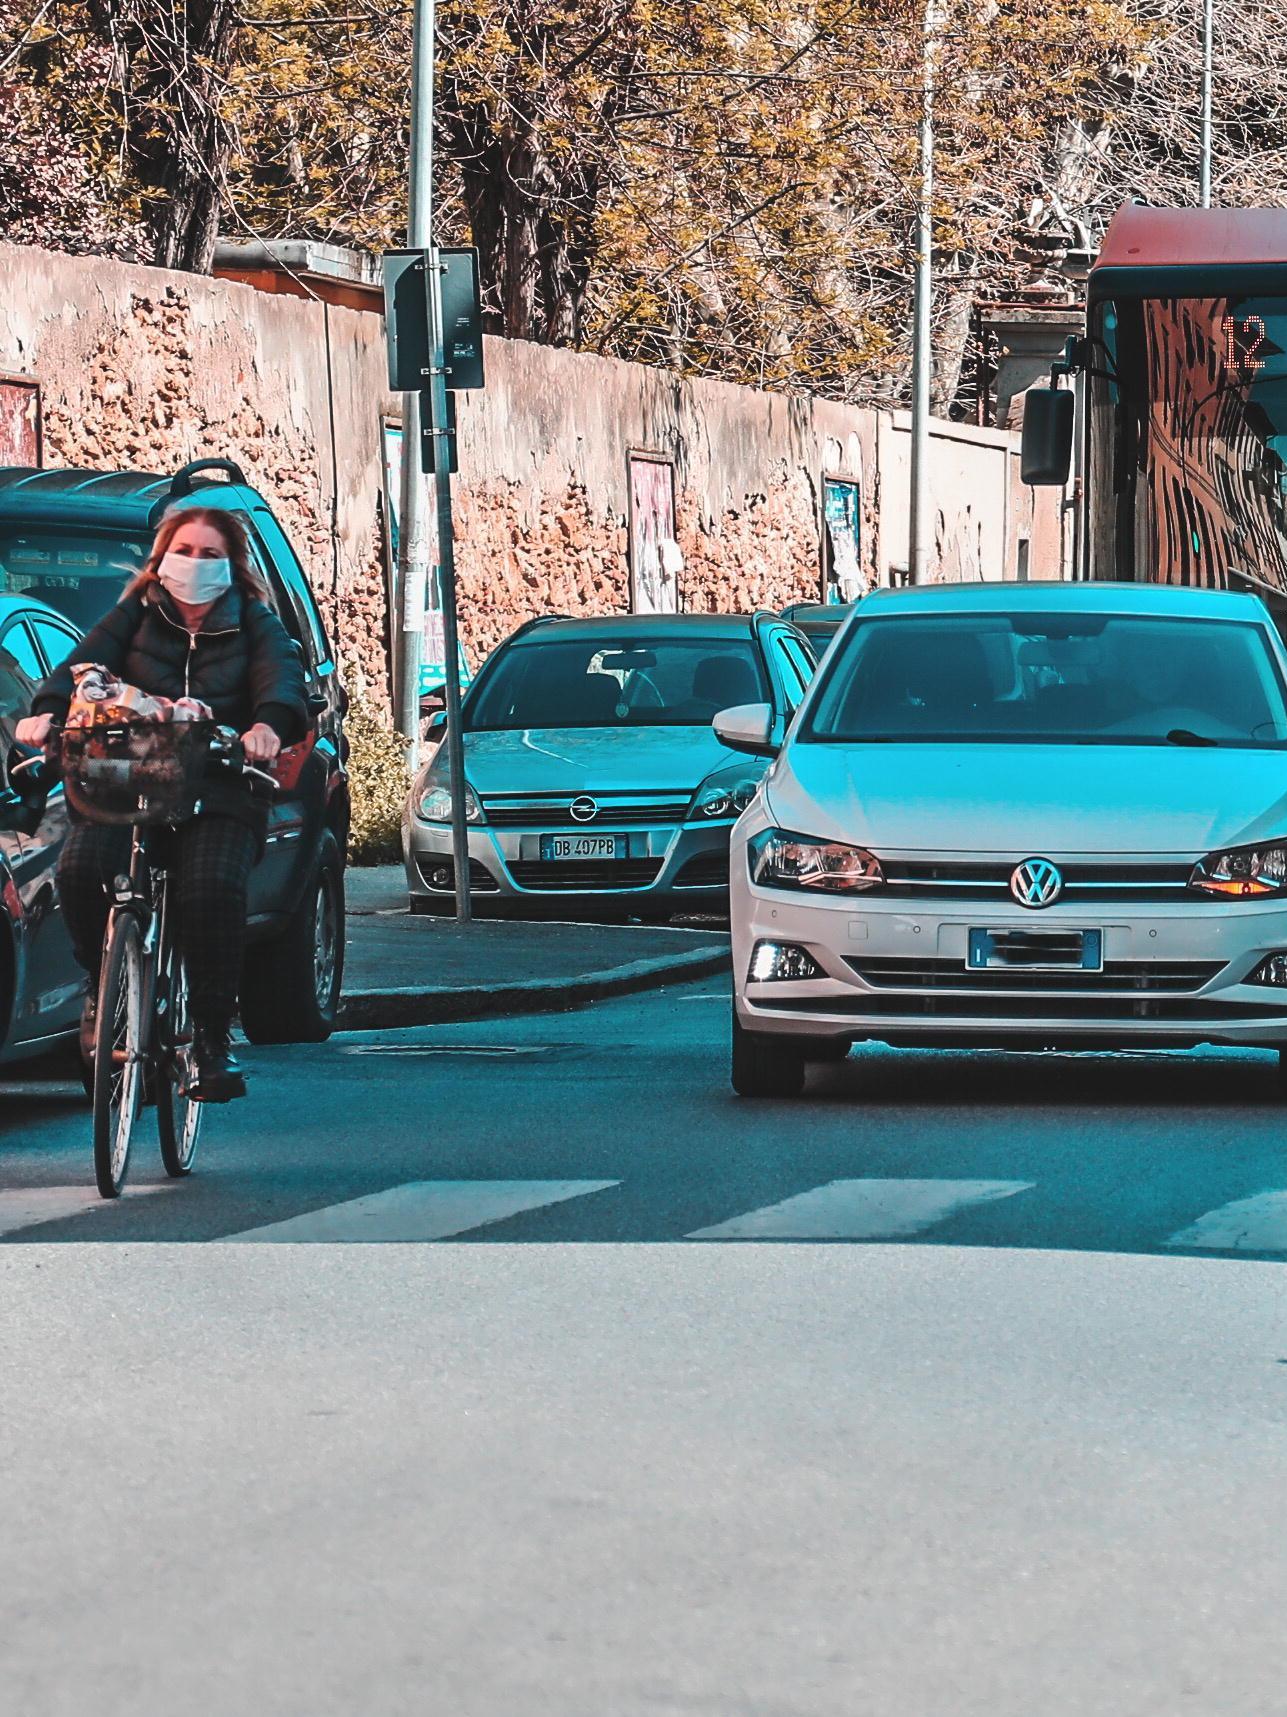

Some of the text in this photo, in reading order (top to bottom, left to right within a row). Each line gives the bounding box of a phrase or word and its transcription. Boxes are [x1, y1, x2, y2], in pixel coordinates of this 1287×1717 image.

[1223, 315, 1266, 369] 12
[554, 839, 614, 857] DB 407PB
